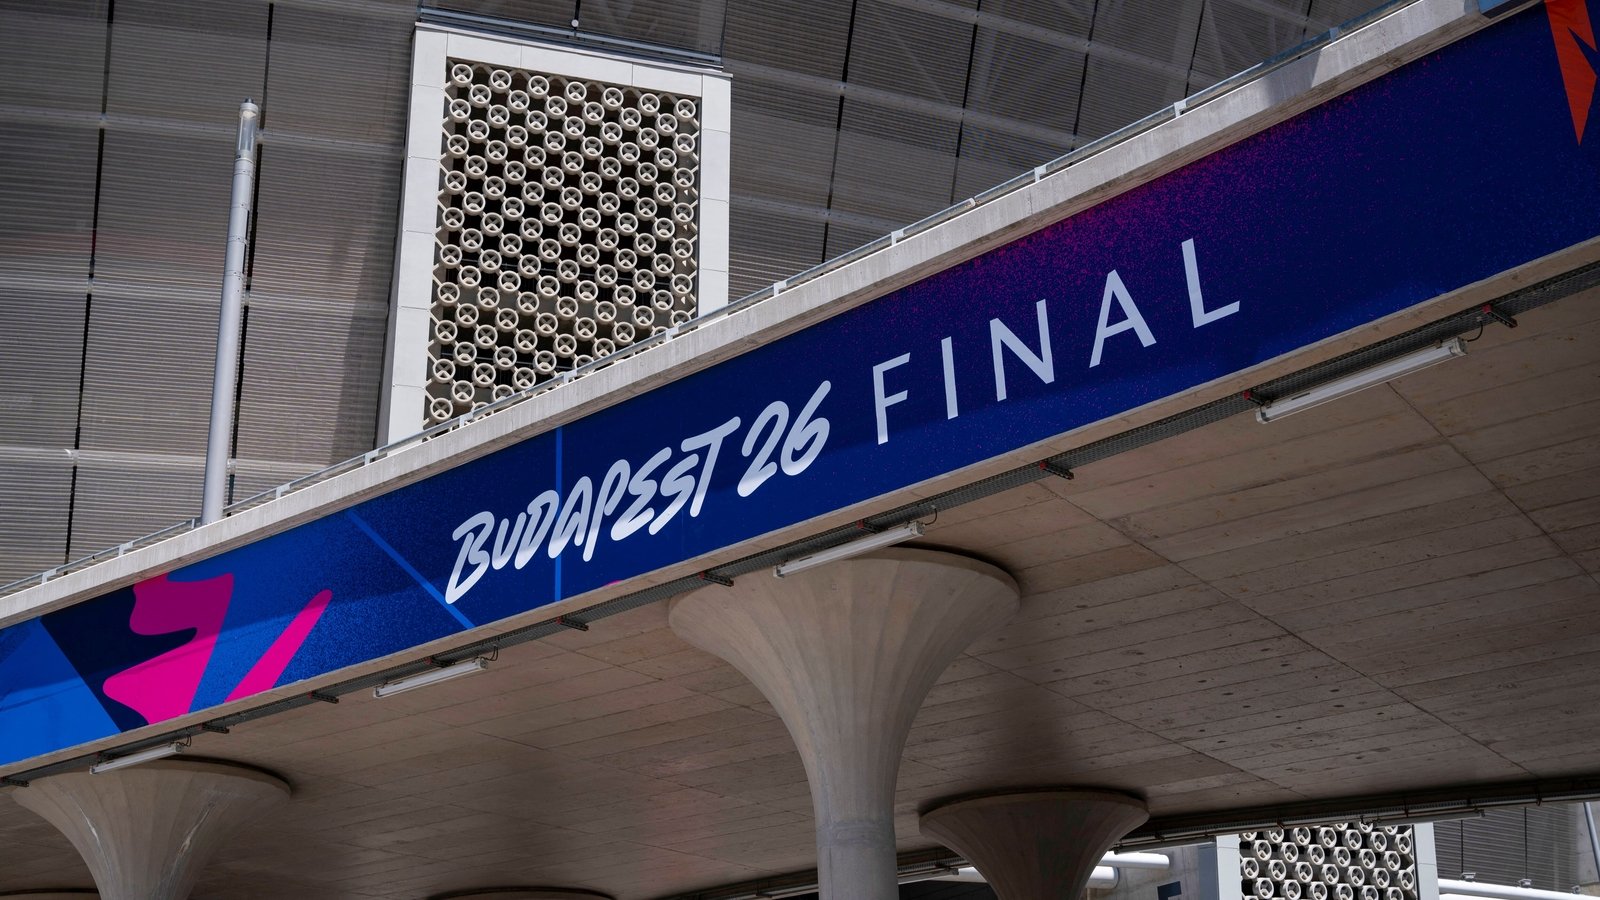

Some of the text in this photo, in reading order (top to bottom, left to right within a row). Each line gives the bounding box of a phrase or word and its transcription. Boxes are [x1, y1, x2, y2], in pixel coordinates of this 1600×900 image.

[445, 238, 1241, 605] BUDAPEST 26 FINAL
